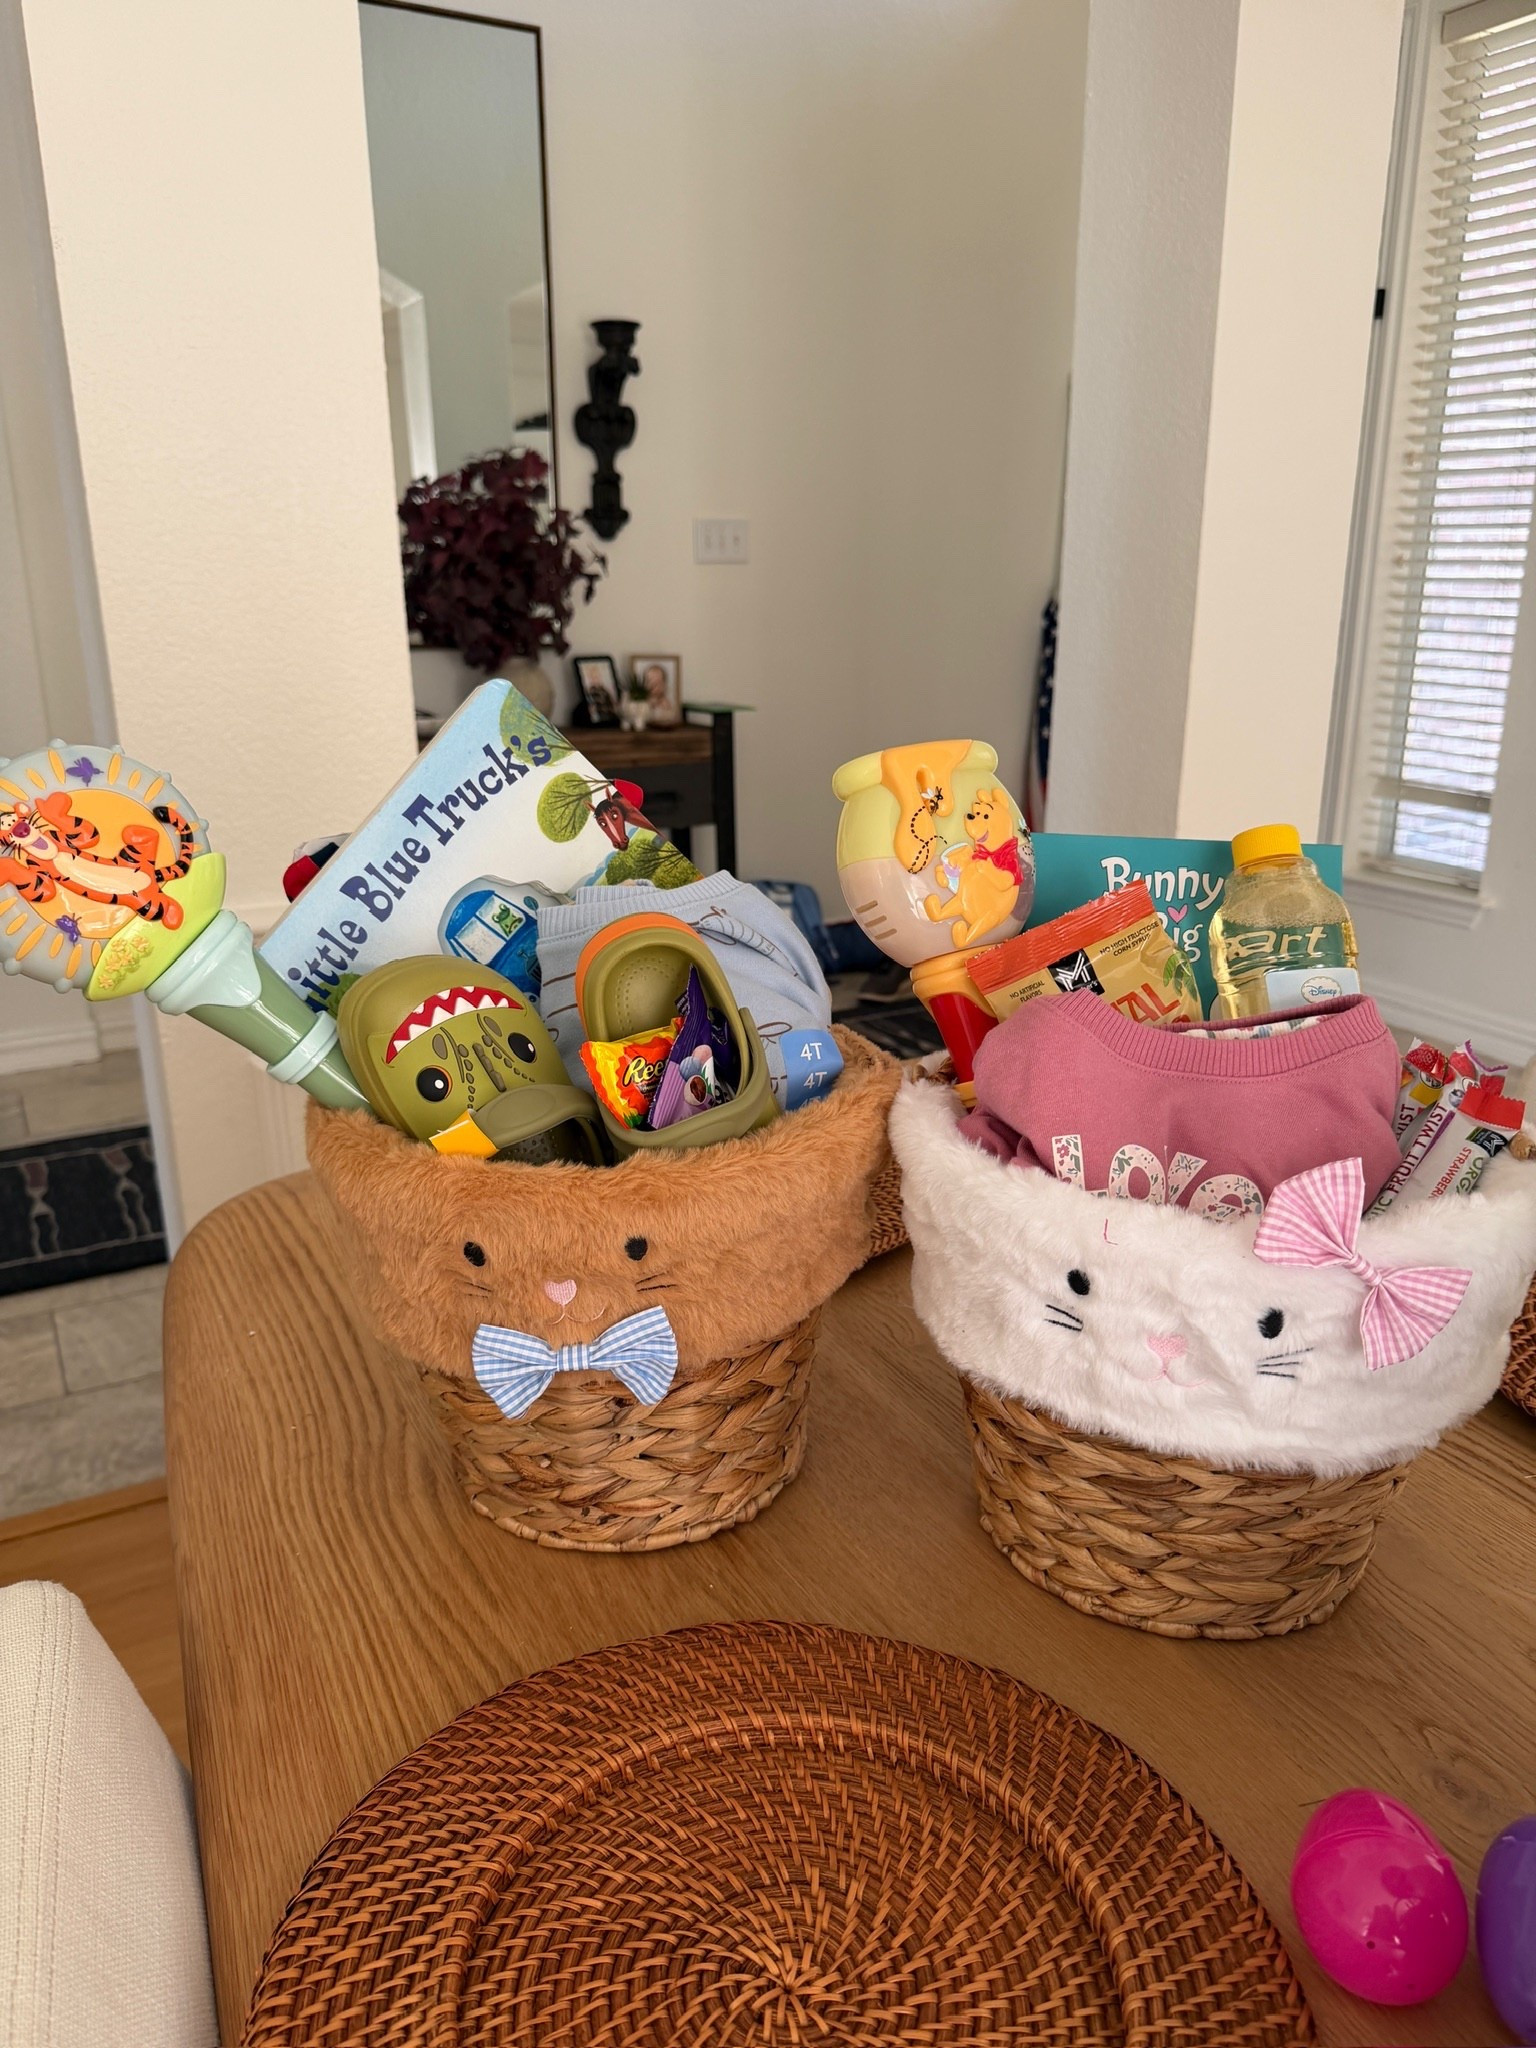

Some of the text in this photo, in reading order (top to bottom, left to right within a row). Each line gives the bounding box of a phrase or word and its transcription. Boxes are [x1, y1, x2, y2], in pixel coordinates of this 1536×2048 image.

[339, 835, 431, 922] Blue
[401, 734, 552, 847] Truck's
[1127, 921, 1160, 944] FRUCTOSE
[1113, 943, 1131, 957] CORN
[1019, 989, 1043, 1003] FLAVORS
[1304, 985, 1338, 997] Disney
[800, 1042, 823, 1061] 4T
[623, 1056, 665, 1087] Ree
[803, 1071, 828, 1089] 4T
[1387, 1151, 1420, 1194] FRUIT
[1413, 1102, 1448, 1149] TWIST
